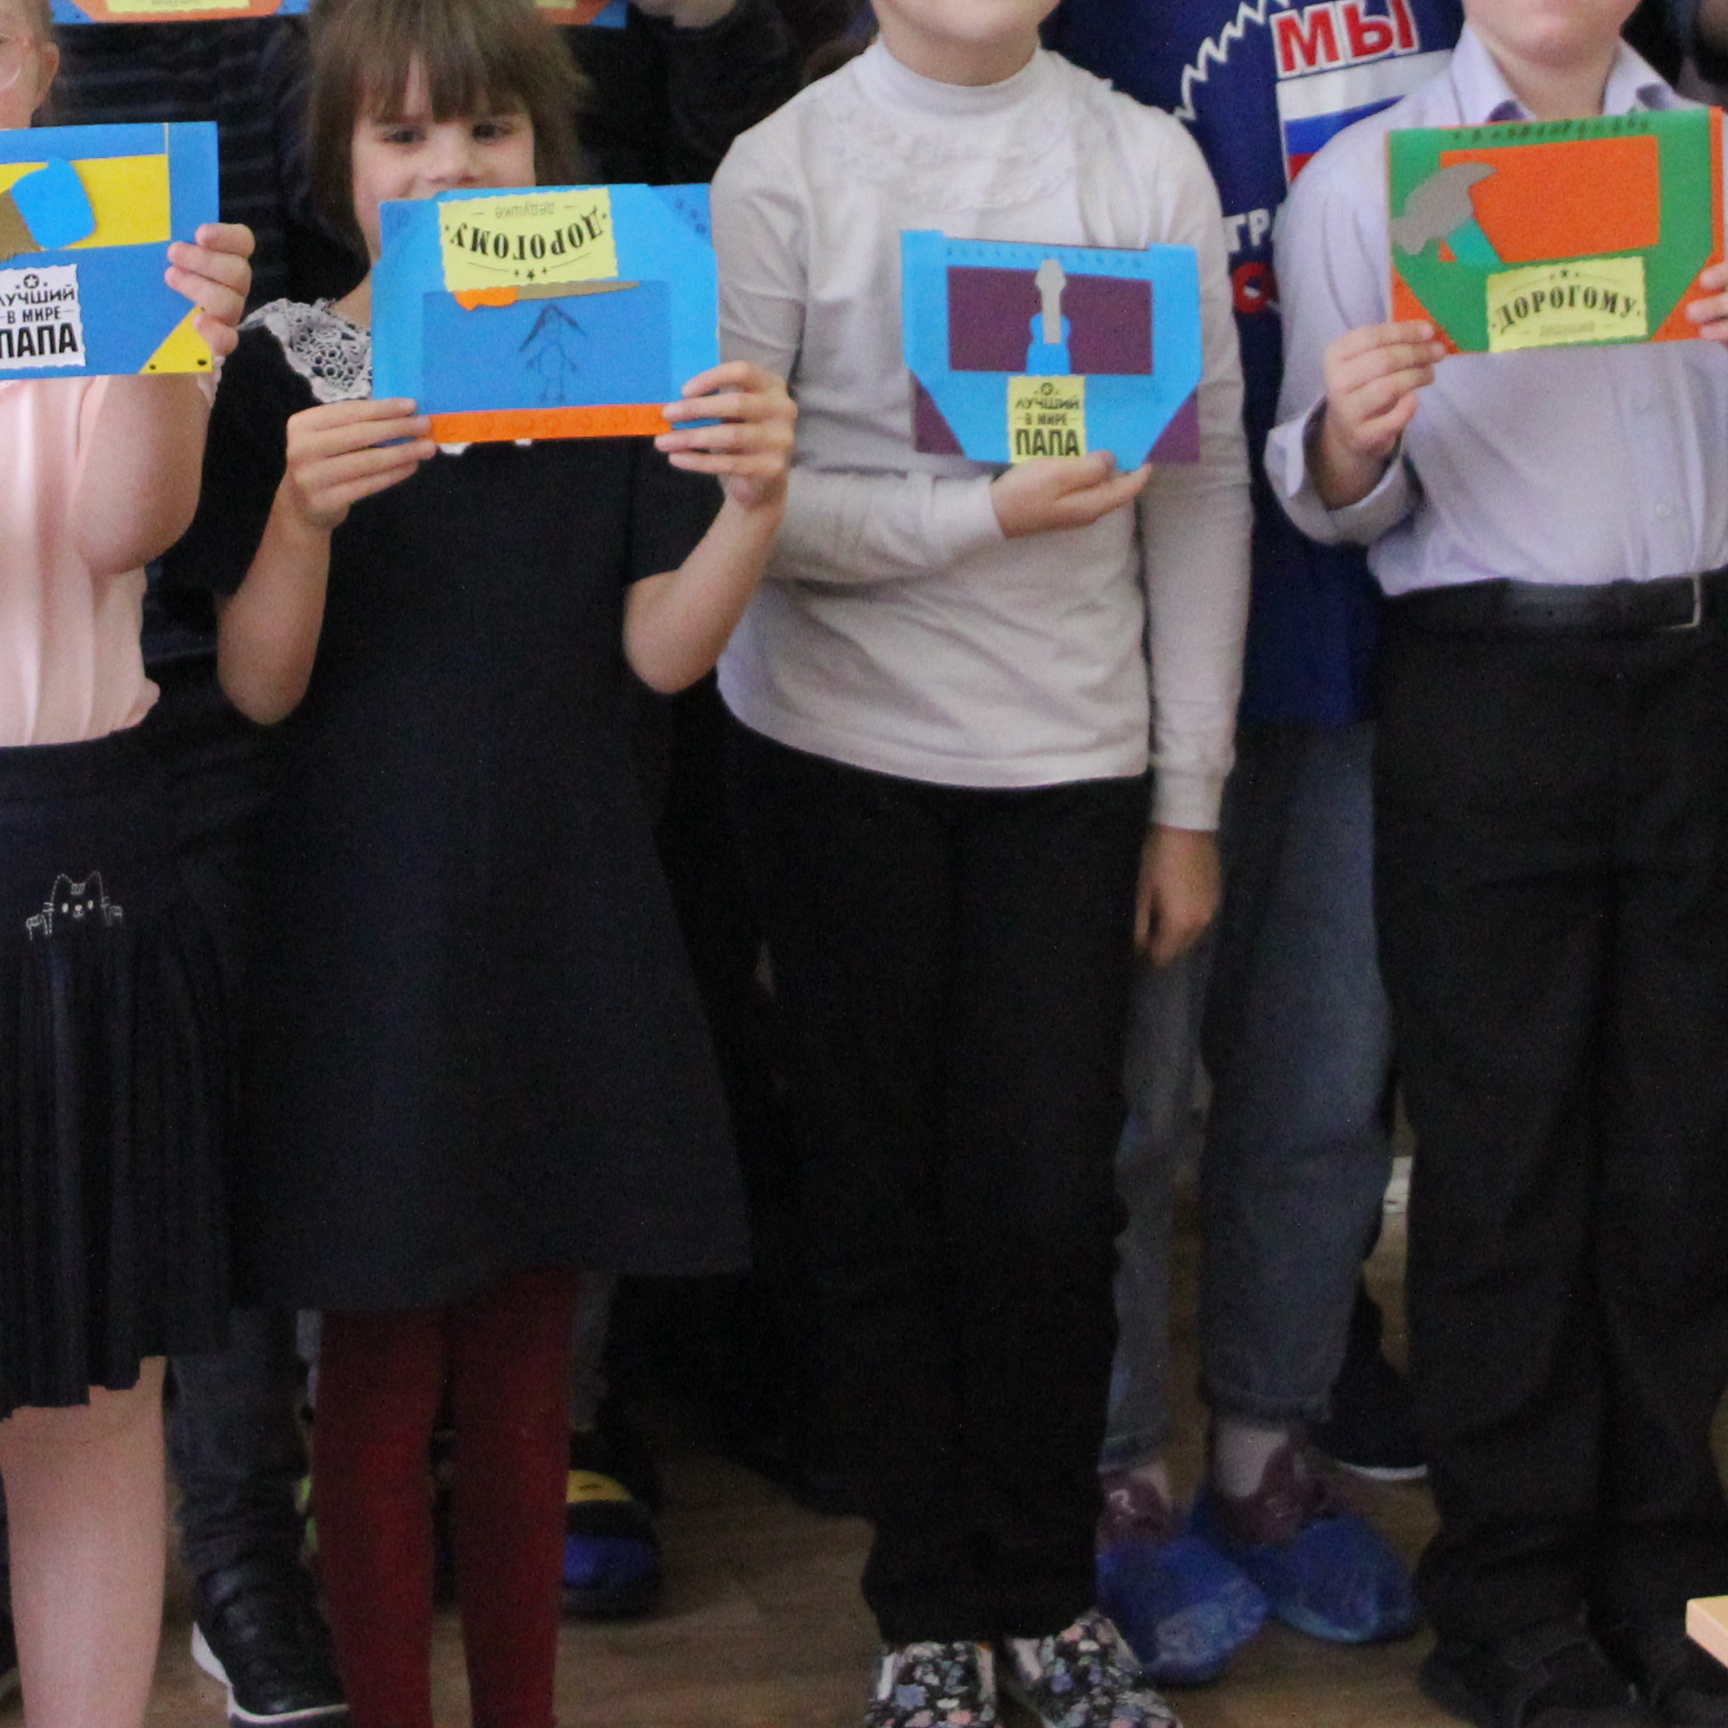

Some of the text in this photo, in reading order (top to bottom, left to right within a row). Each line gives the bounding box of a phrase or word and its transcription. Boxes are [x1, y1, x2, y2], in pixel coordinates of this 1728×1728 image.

[449, 205, 604, 261] ДОРОГОМУ
[7, 305, 61, 324] В МИРЕ
[1496, 285, 1637, 335] ДОРОГОМУ
[1016, 428, 1080, 457] ПАПА
